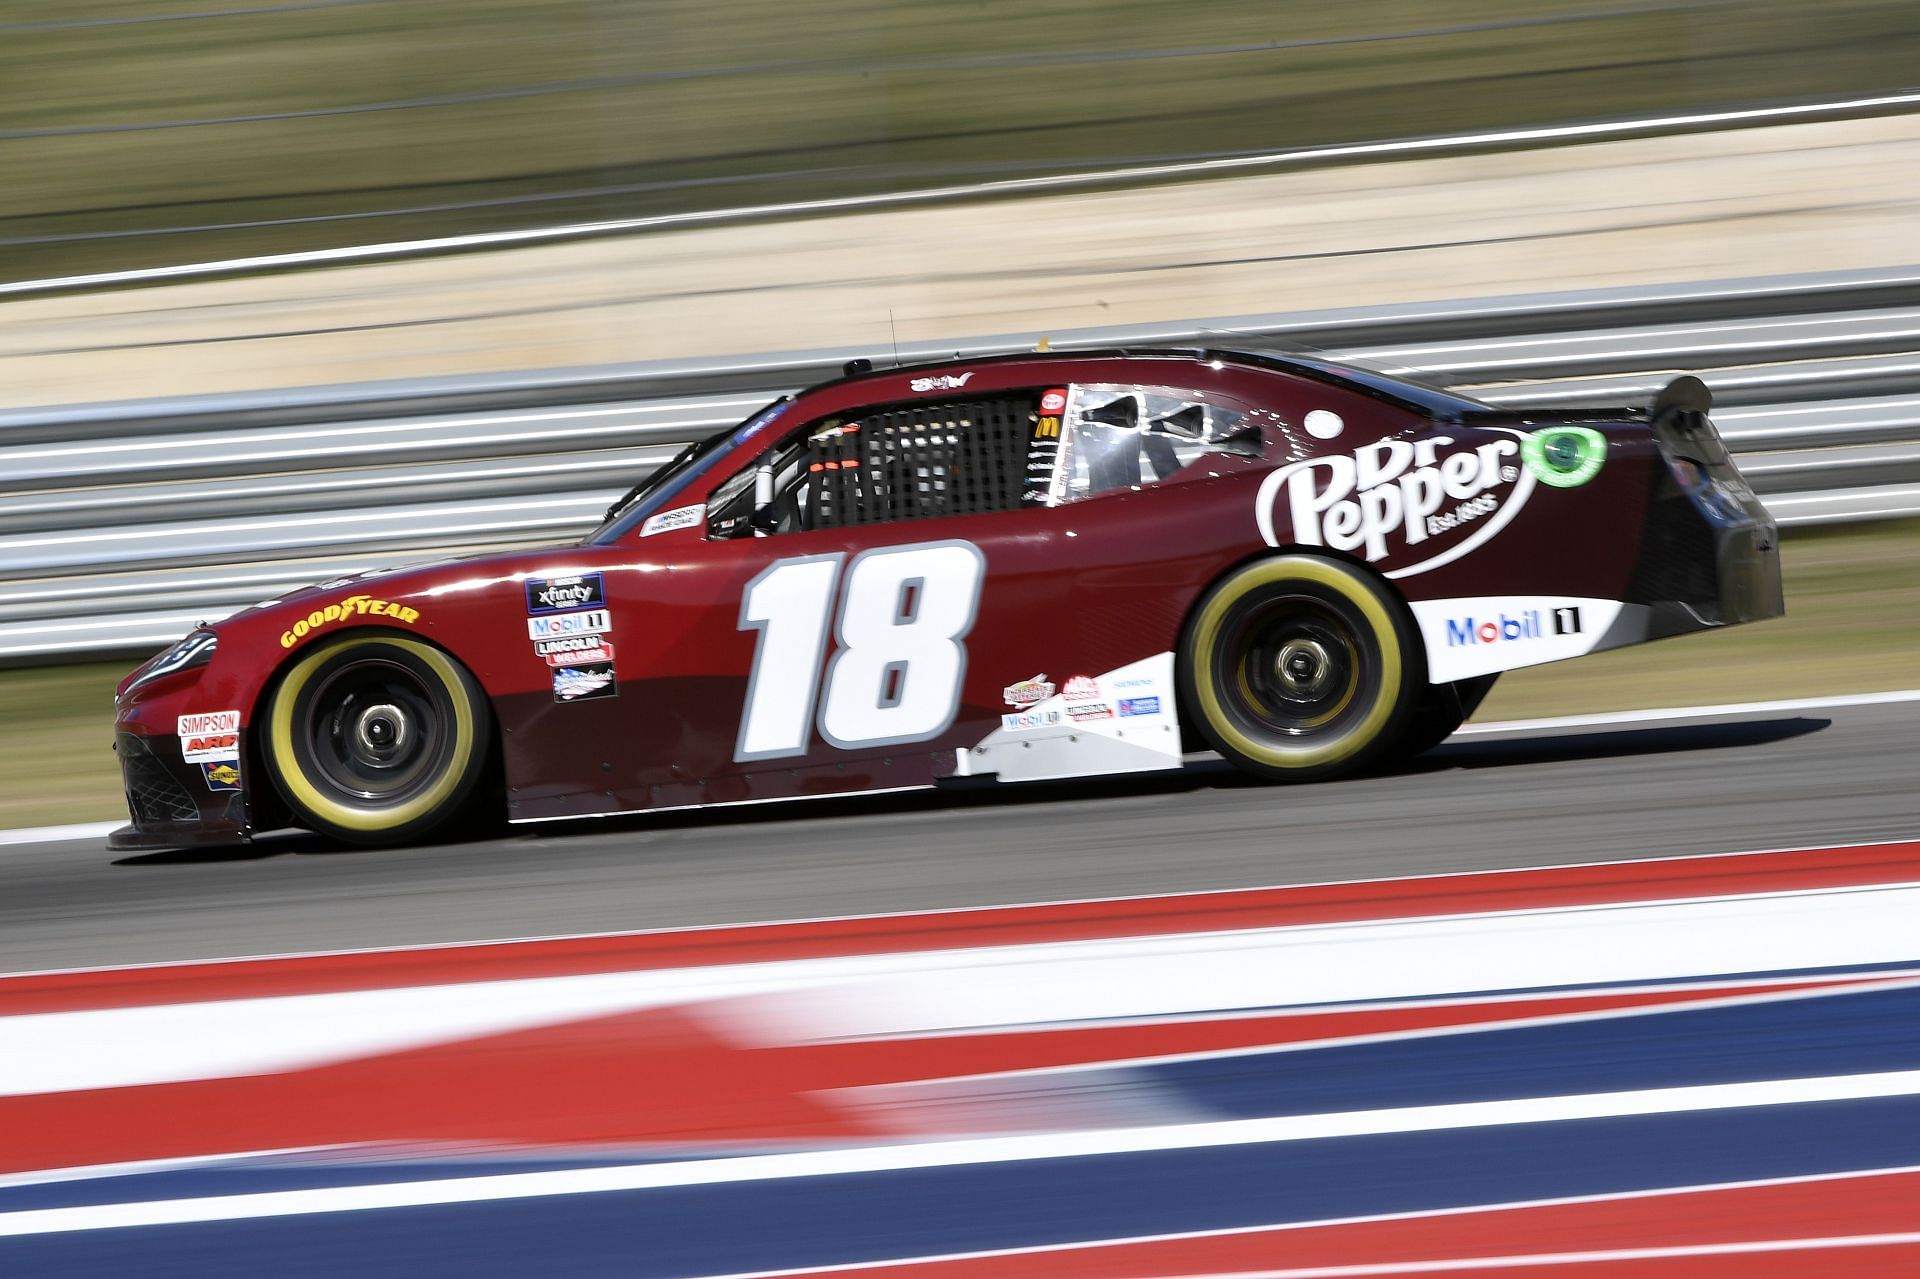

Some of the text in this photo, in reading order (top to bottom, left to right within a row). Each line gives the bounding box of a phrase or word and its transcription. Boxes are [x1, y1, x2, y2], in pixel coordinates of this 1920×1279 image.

[1354, 436, 1455, 492] Dr
[1284, 439, 1519, 563] Pepper
[538, 584, 593, 606] xfinity
[280, 595, 420, 648] GOODYEAR
[534, 614, 603, 632] Mobil 1
[1446, 606, 1582, 647] Mobil 1
[538, 636, 600, 654] LINCOLN
[734, 538, 988, 762] 18
[181, 714, 236, 734] SIMPSON
